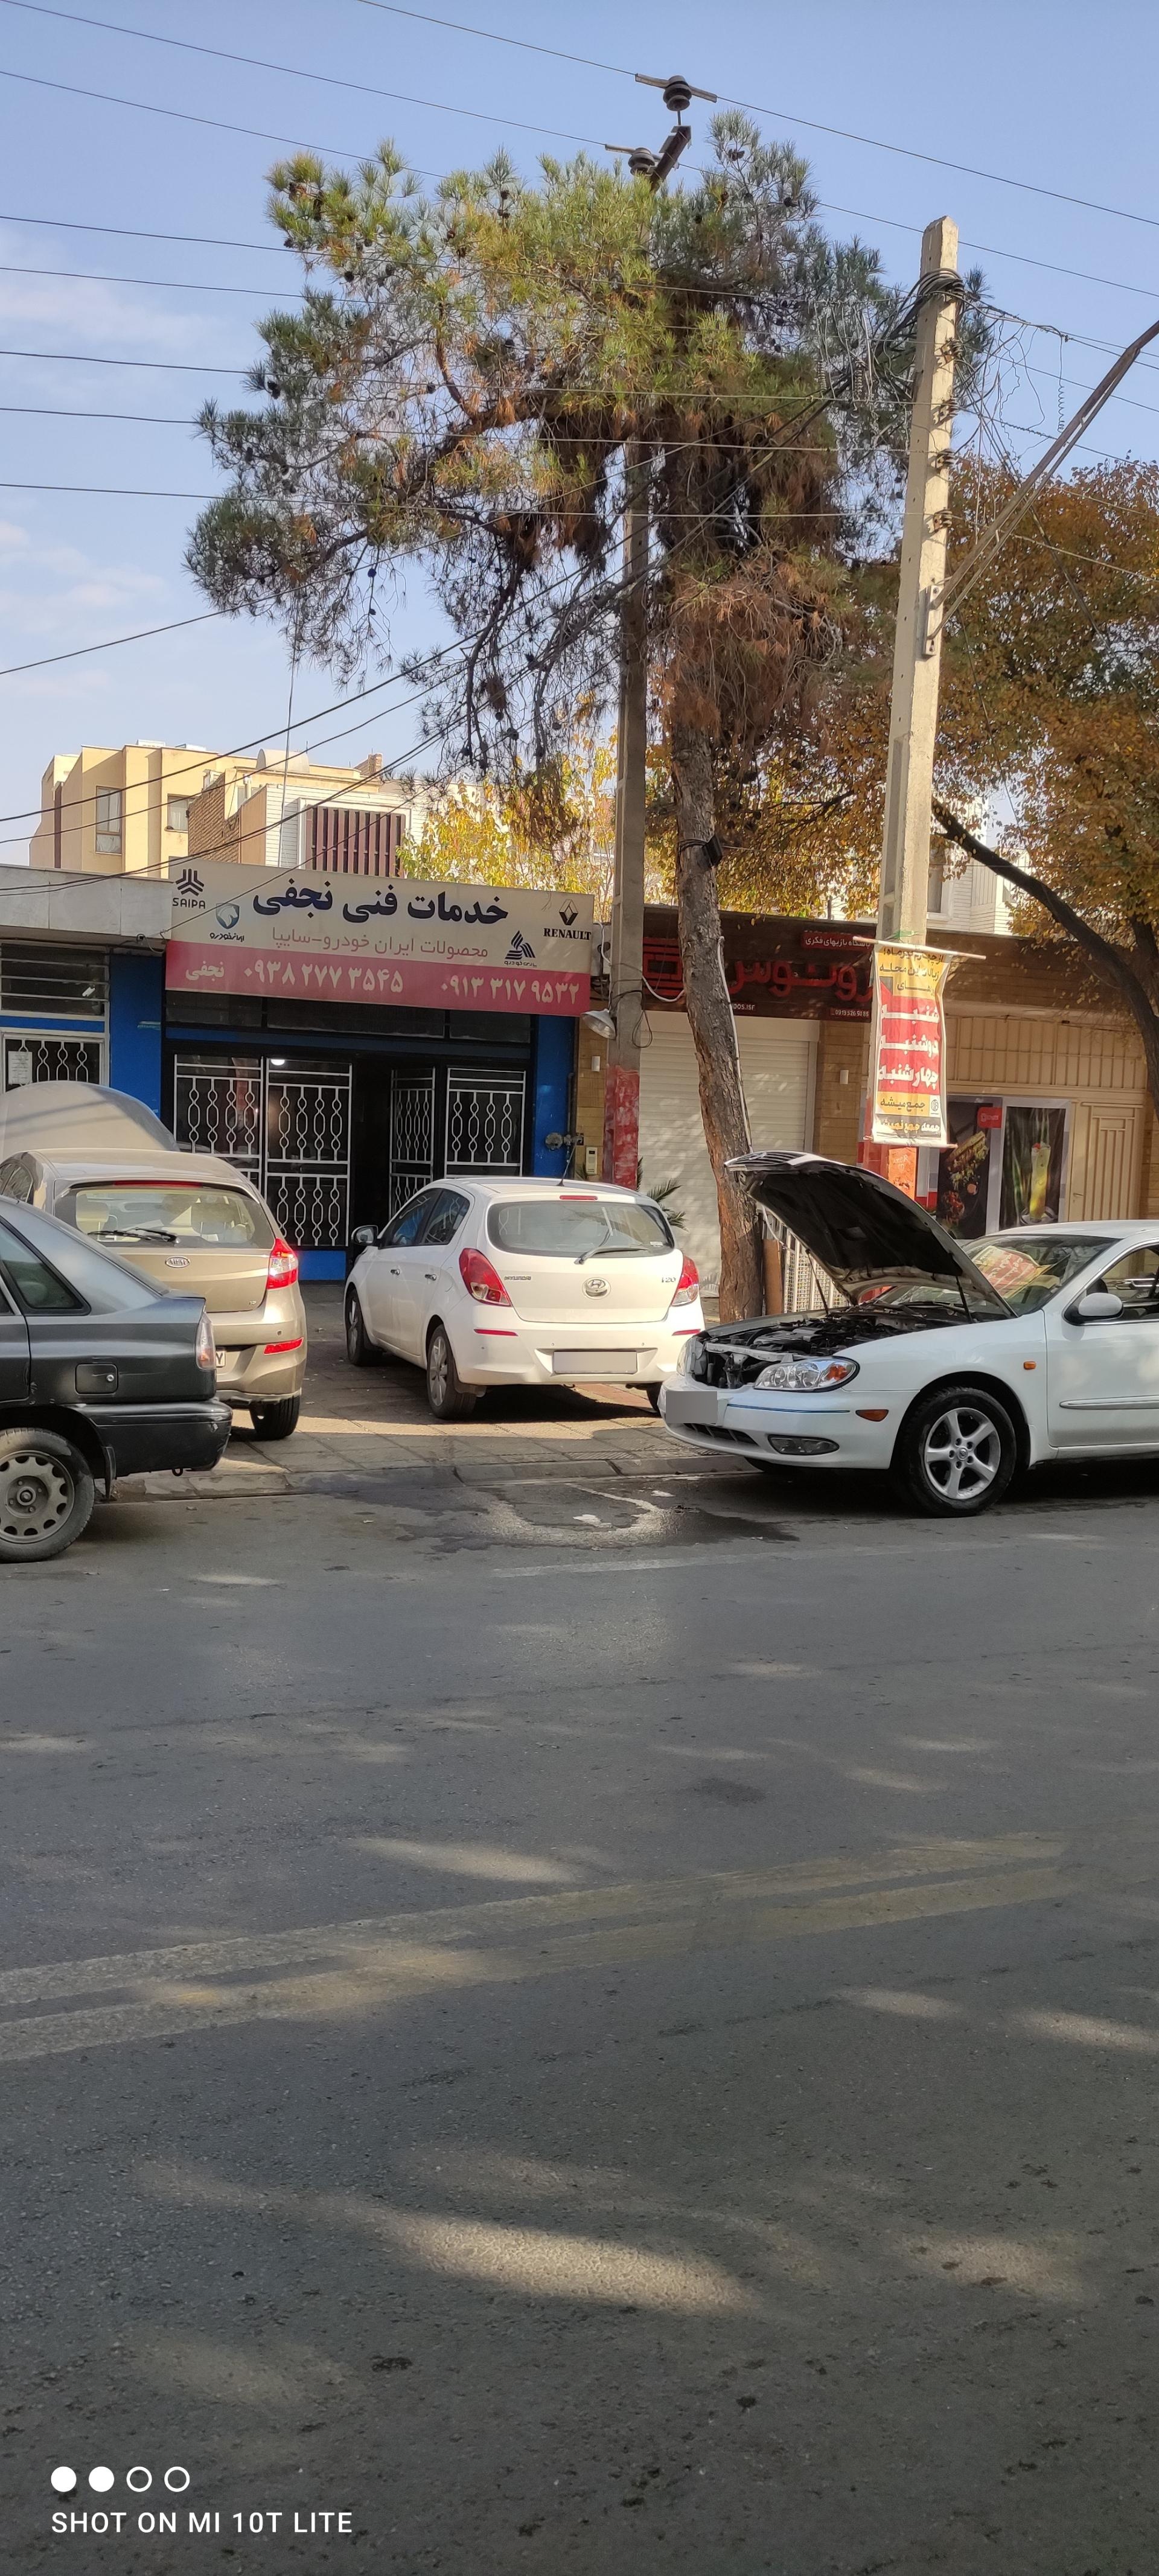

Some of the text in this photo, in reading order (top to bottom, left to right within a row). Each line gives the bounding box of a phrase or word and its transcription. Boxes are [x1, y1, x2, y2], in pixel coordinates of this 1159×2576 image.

[173, 897, 206, 910] SAIPA
[253, 878, 509, 924] خدمات فنی نجفی
[543, 928, 592, 940] RENAULT
[374, 936, 414, 956] ایران
[421, 940, 488, 960] محصولات
[185, 960, 225, 981] نجفی
[244, 959, 404, 993] ۰۹۳۸ ۲۷۷ ۳۵۴۵
[441, 975, 580, 1005] ۰۹۱۳ ۳۱۷ ۹۵۳۲
[905, 1101, 925, 1112] جمع
